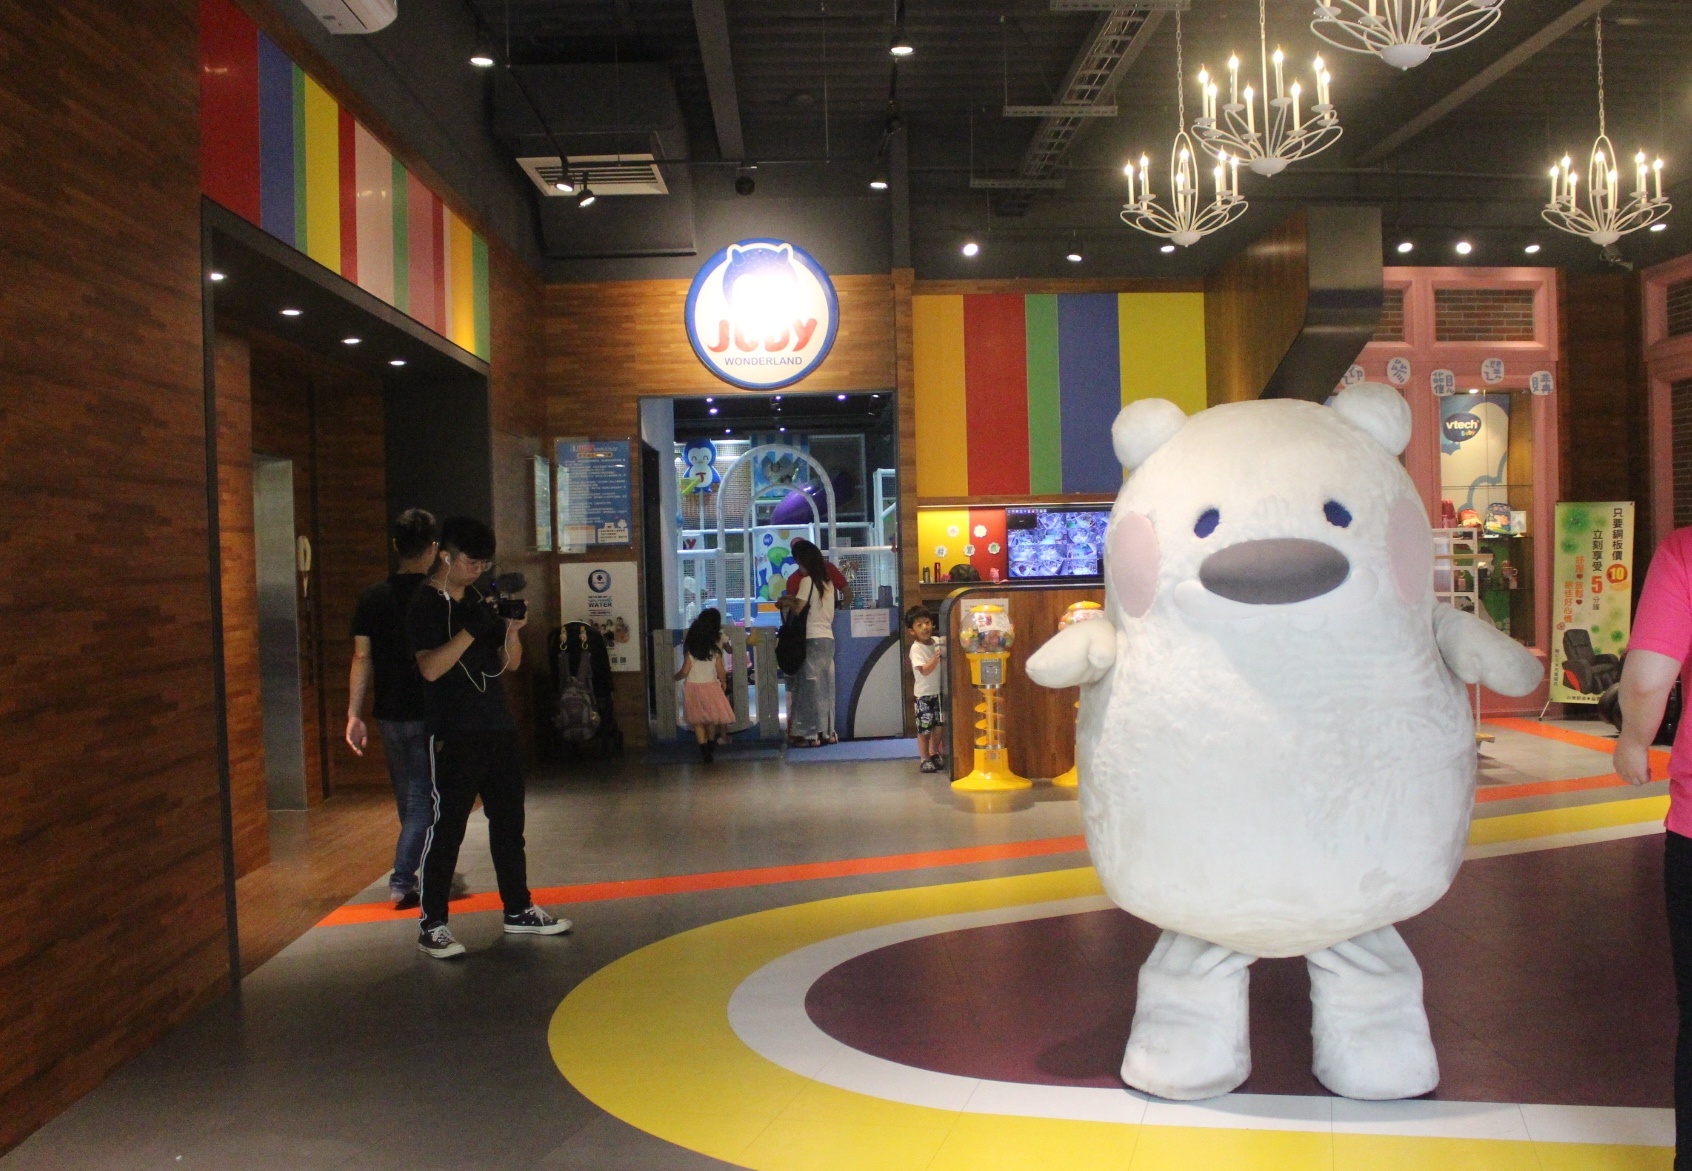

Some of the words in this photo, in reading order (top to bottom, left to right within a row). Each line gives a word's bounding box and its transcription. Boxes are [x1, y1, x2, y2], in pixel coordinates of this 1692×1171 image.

[724, 356, 803, 366] WONDERLAND
[1445, 420, 1478, 429] vtech
[1612, 508, 1624, 561] 只要銅板價
[1592, 530, 1604, 572] 立刻享受
[1610, 567, 1625, 581] 10
[1591, 575, 1603, 594] 5
